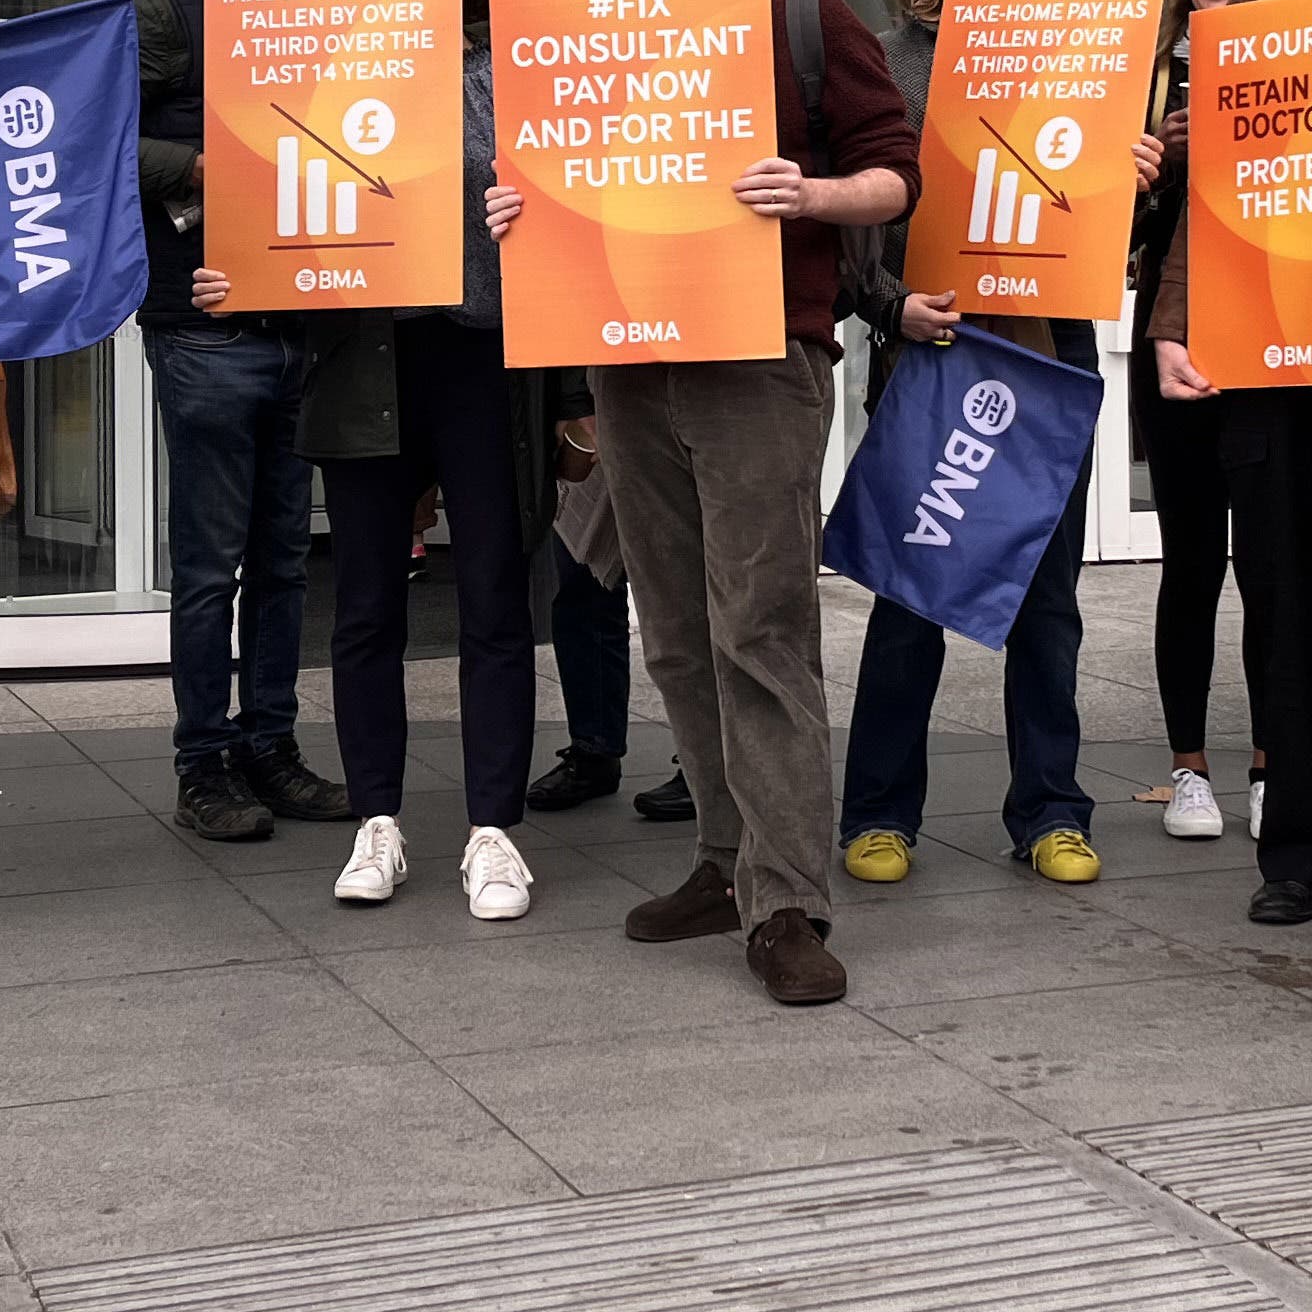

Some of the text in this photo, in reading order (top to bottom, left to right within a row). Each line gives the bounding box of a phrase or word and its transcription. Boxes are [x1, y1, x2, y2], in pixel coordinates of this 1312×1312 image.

[242, 2, 424, 29] FALLEN BY OVER
[954, 0, 1147, 22] TAKE-HOME PAY HAS
[232, 30, 434, 57] A THIRD OVER THE
[512, 25, 751, 67] CONSULTANT
[967, 28, 1123, 47] FALLEN BY OVER
[1219, 36, 1256, 66] FIX
[252, 59, 414, 84] LAST 14 YEARS
[953, 54, 1128, 73] A THIRD OVER THE
[554, 69, 711, 105] PAY NOW
[967, 80, 1106, 99] LAST 14 YEARS
[1219, 74, 1308, 112] RETAIN
[359, 111, 379, 143] £
[516, 109, 754, 149] AND FOR THE
[1048, 128, 1068, 159] £
[565, 153, 707, 188] FUTURE
[1238, 189, 1290, 218] THE
[5, 152, 70, 293] BMA
[319, 270, 367, 289] BMA
[997, 277, 1038, 296] BMA
[628, 322, 680, 342] BMA
[904, 429, 995, 546] BMA
